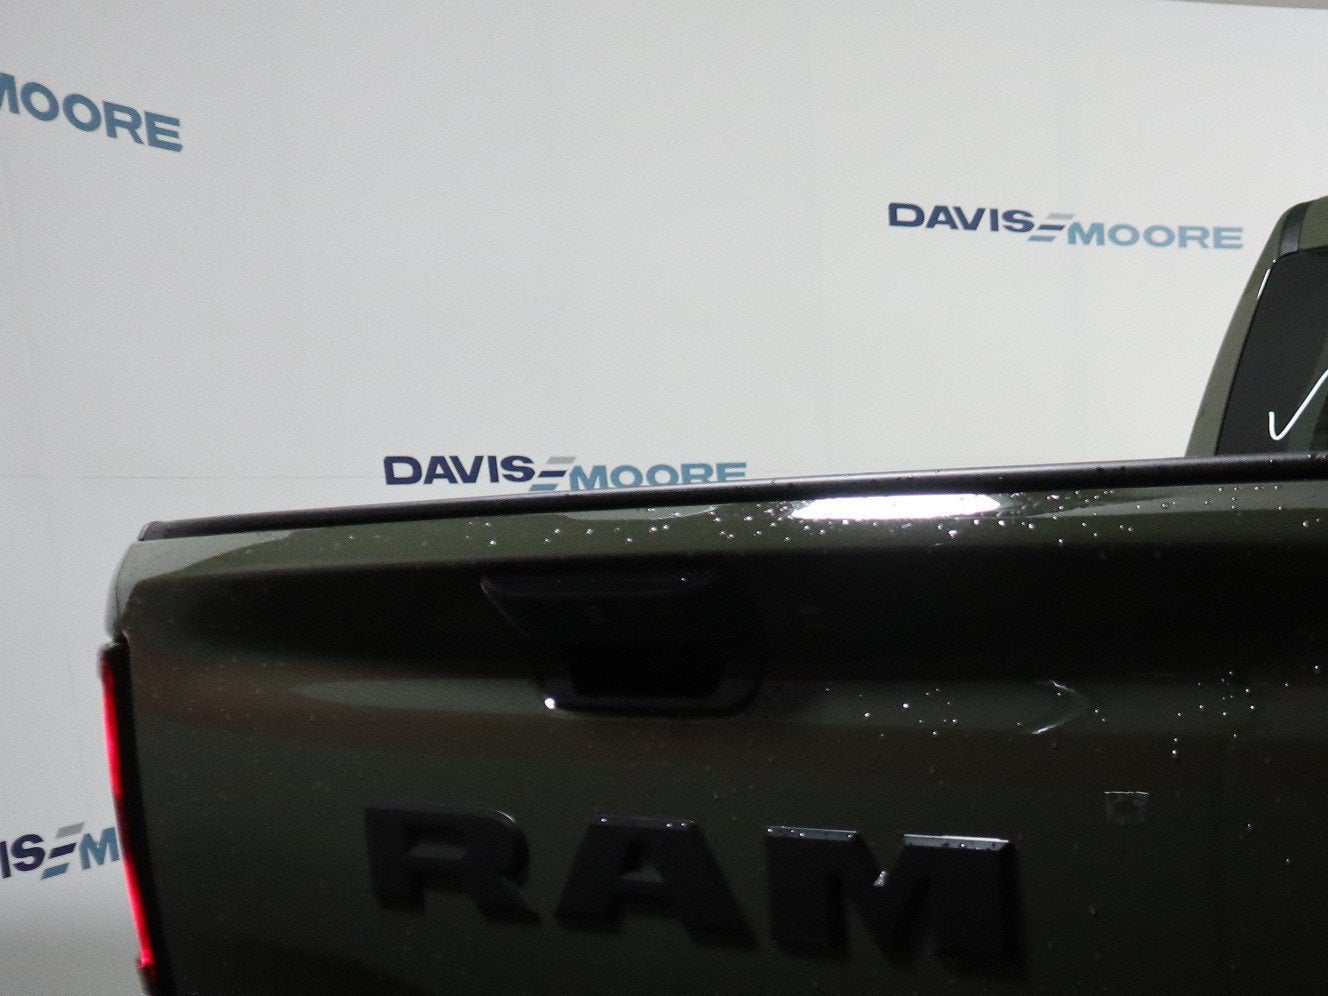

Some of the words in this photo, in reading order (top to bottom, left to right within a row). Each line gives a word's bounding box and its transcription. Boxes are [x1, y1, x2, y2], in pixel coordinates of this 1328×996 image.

[888, 202, 1034, 232] DAVIS
[1067, 222, 1244, 249] MOORE
[383, 455, 536, 485] DAVIS
[569, 461, 747, 492] MOORE
[364, 806, 1024, 978] RAM
